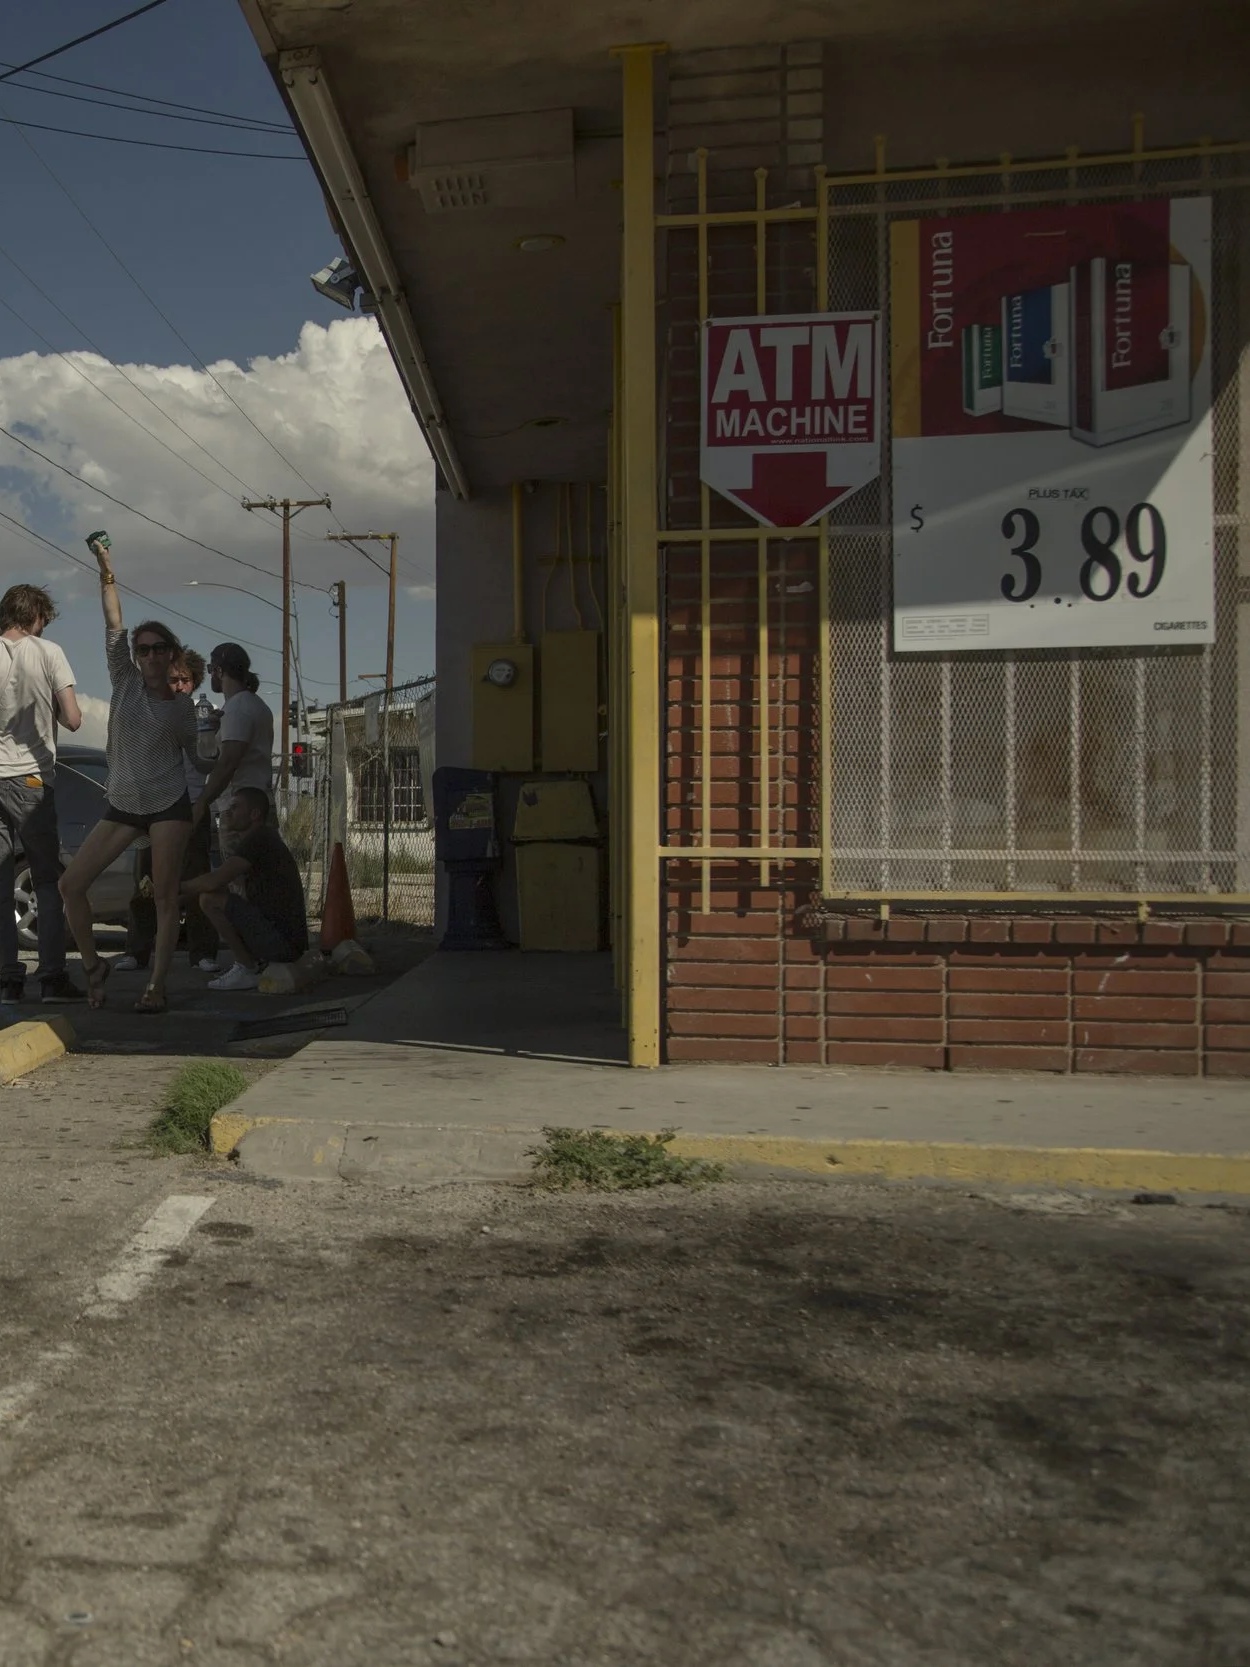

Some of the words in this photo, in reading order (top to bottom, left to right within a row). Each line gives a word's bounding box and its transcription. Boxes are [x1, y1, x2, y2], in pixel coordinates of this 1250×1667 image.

[927, 231, 954, 350] Fortuna
[1111, 263, 1132, 368] Fortuna
[981, 327, 993, 379] Fortuna
[1009, 295, 1024, 369] Fortuna
[711, 323, 874, 404] ATM
[716, 405, 868, 437] MACHINE
[909, 503, 925, 533] $
[1029, 488, 1060, 499] PLUS
[1063, 488, 1090, 500] TAX
[1153, 621, 1209, 631] CIGARETTES
